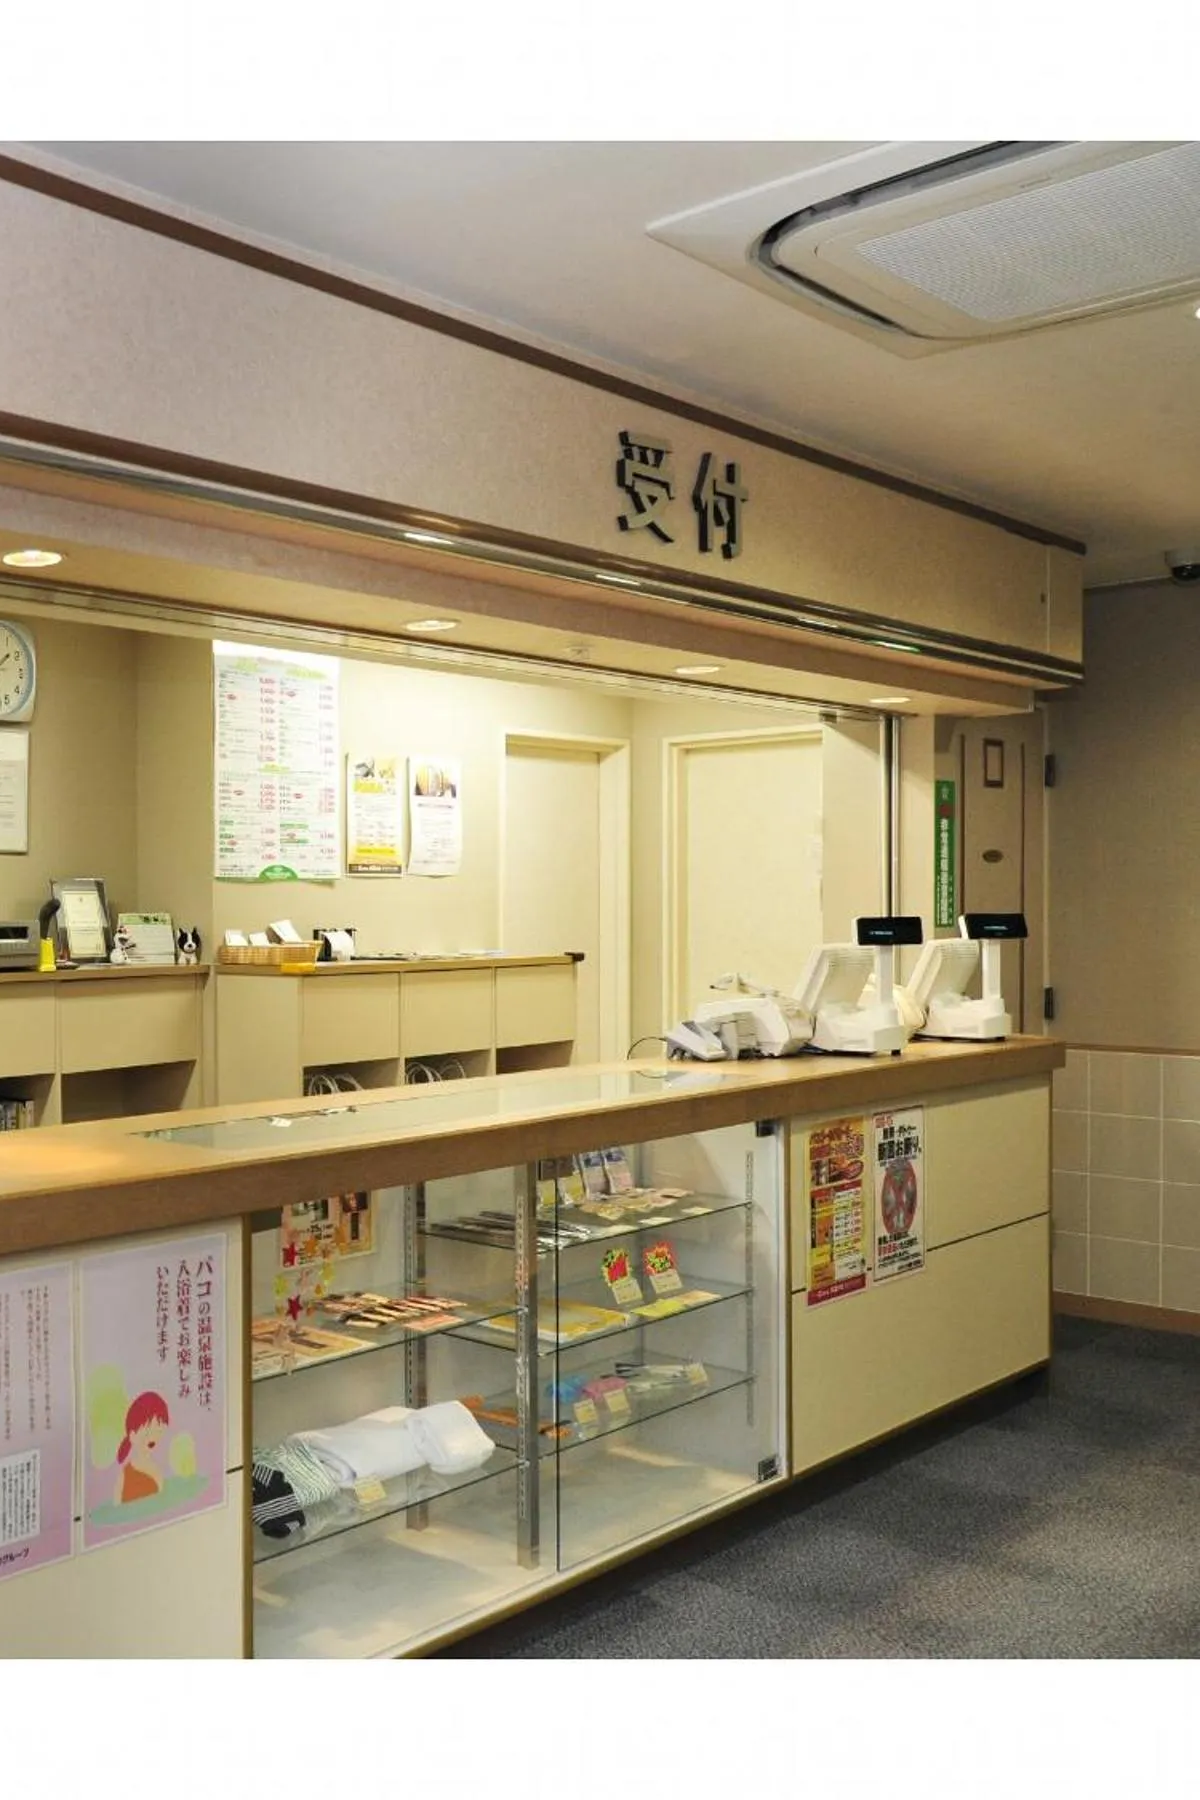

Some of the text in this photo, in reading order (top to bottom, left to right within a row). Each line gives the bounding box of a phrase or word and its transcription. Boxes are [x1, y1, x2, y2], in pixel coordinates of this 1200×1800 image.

[616, 431, 748, 560] 受付
[156, 1265, 169, 1364] いただけます
